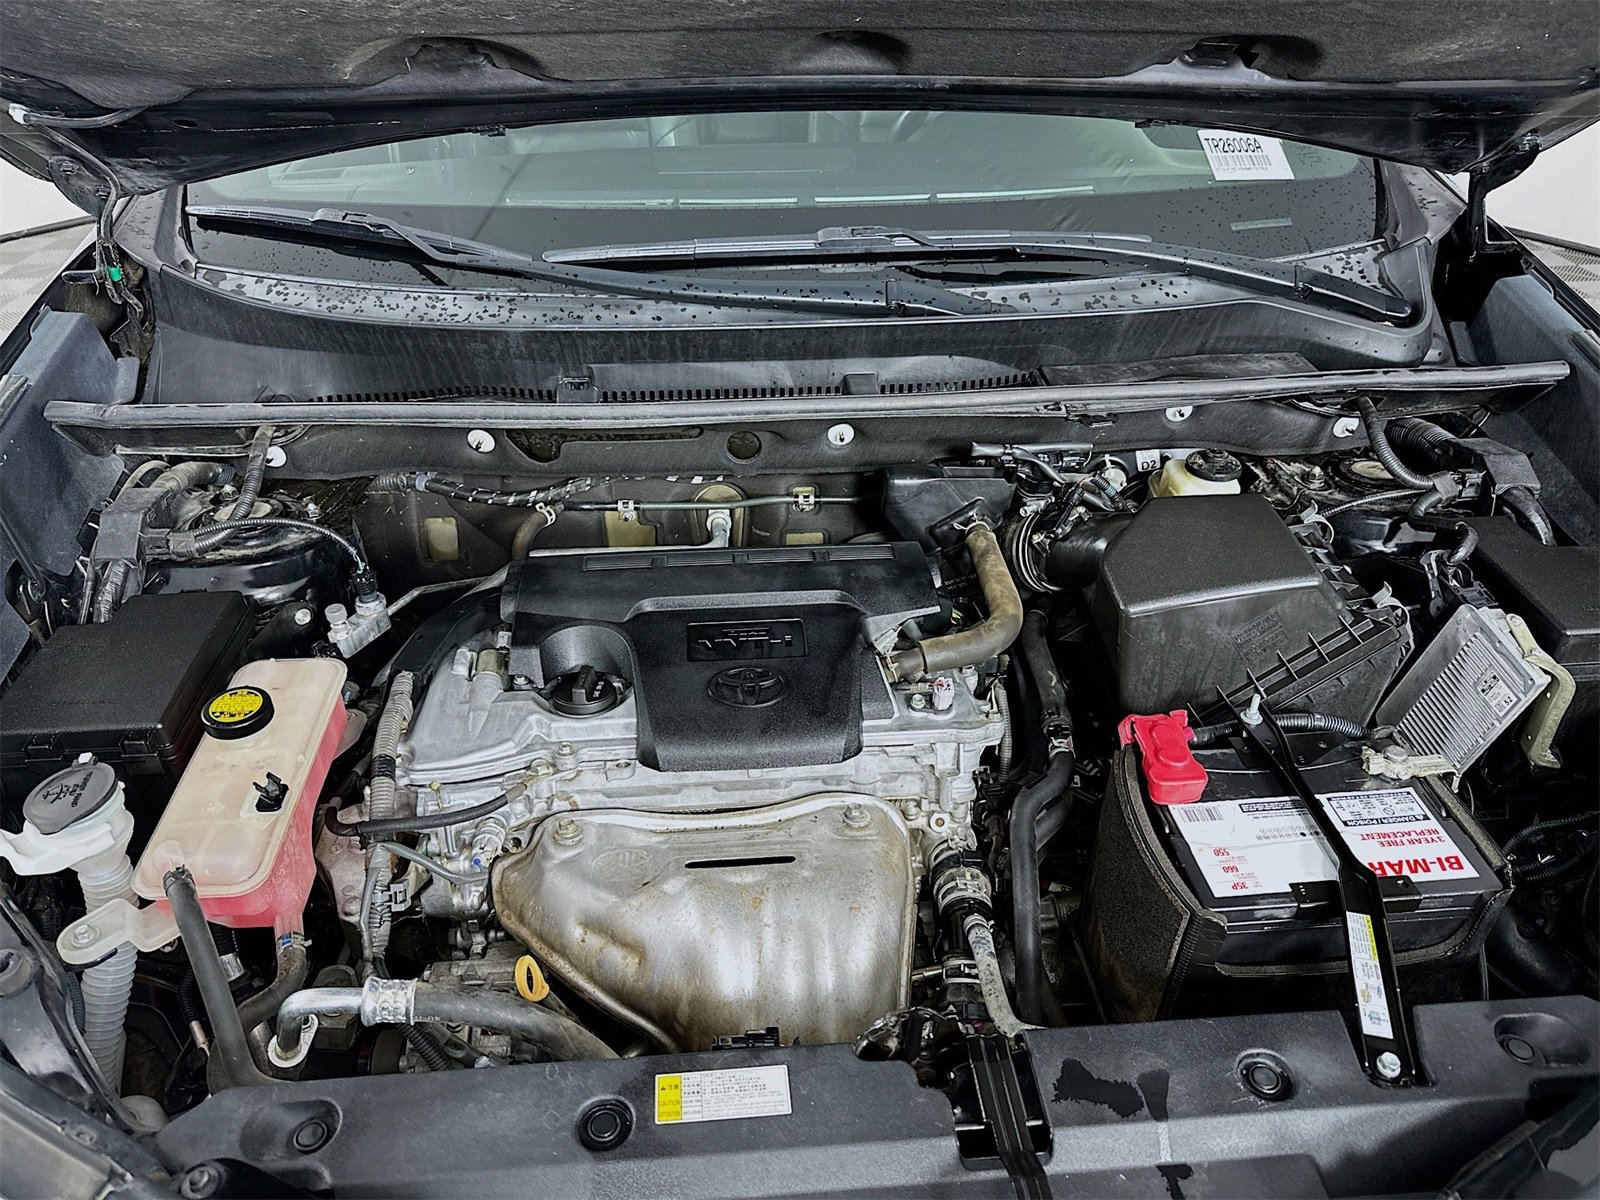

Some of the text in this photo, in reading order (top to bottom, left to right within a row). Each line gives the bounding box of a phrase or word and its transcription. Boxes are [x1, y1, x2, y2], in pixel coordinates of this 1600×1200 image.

[1204, 138, 1264, 154] TR26006A
[1141, 459, 1157, 471] D2
[1347, 818, 1376, 826] POISON
[1383, 815, 1416, 824] DANGER
[1360, 828, 1439, 840] REPLACEMENT
[1379, 839, 1405, 847] FREE
[1368, 855, 1464, 876] BI-MAR
